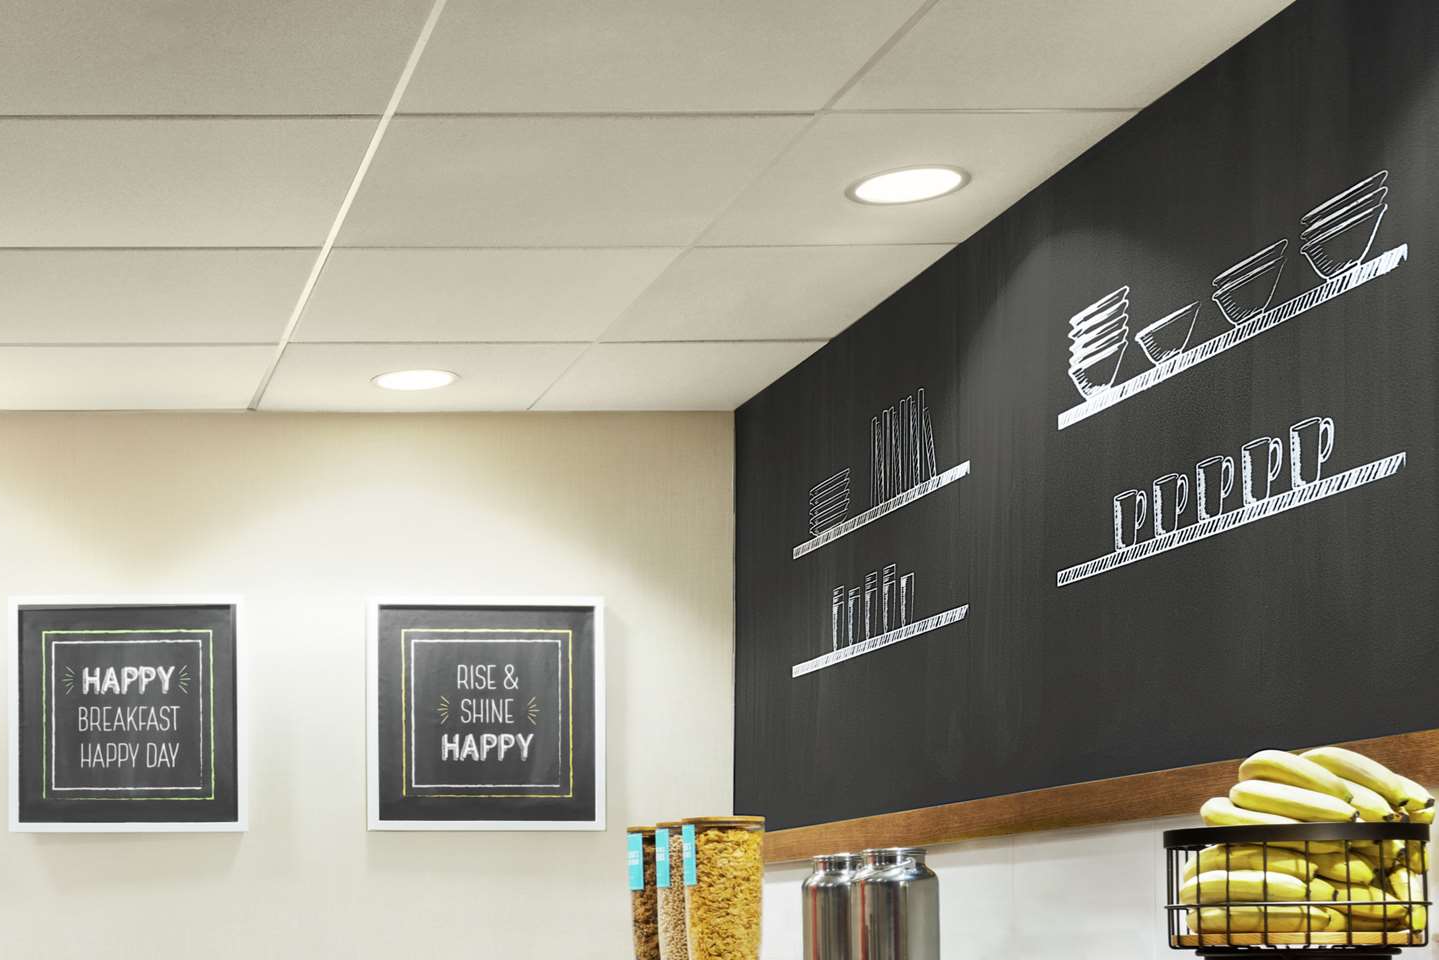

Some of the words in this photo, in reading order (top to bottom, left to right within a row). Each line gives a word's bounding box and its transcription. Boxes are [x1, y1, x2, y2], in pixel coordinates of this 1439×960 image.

[81, 665, 176, 695] HAPPY
[457, 664, 497, 690] RISE
[503, 664, 519, 690] &
[78, 705, 181, 732] BREAKFAST
[460, 698, 515, 724] SHINE
[80, 742, 140, 769] HAPPY
[146, 742, 180, 769] DAY
[441, 733, 535, 762] HAPPY
